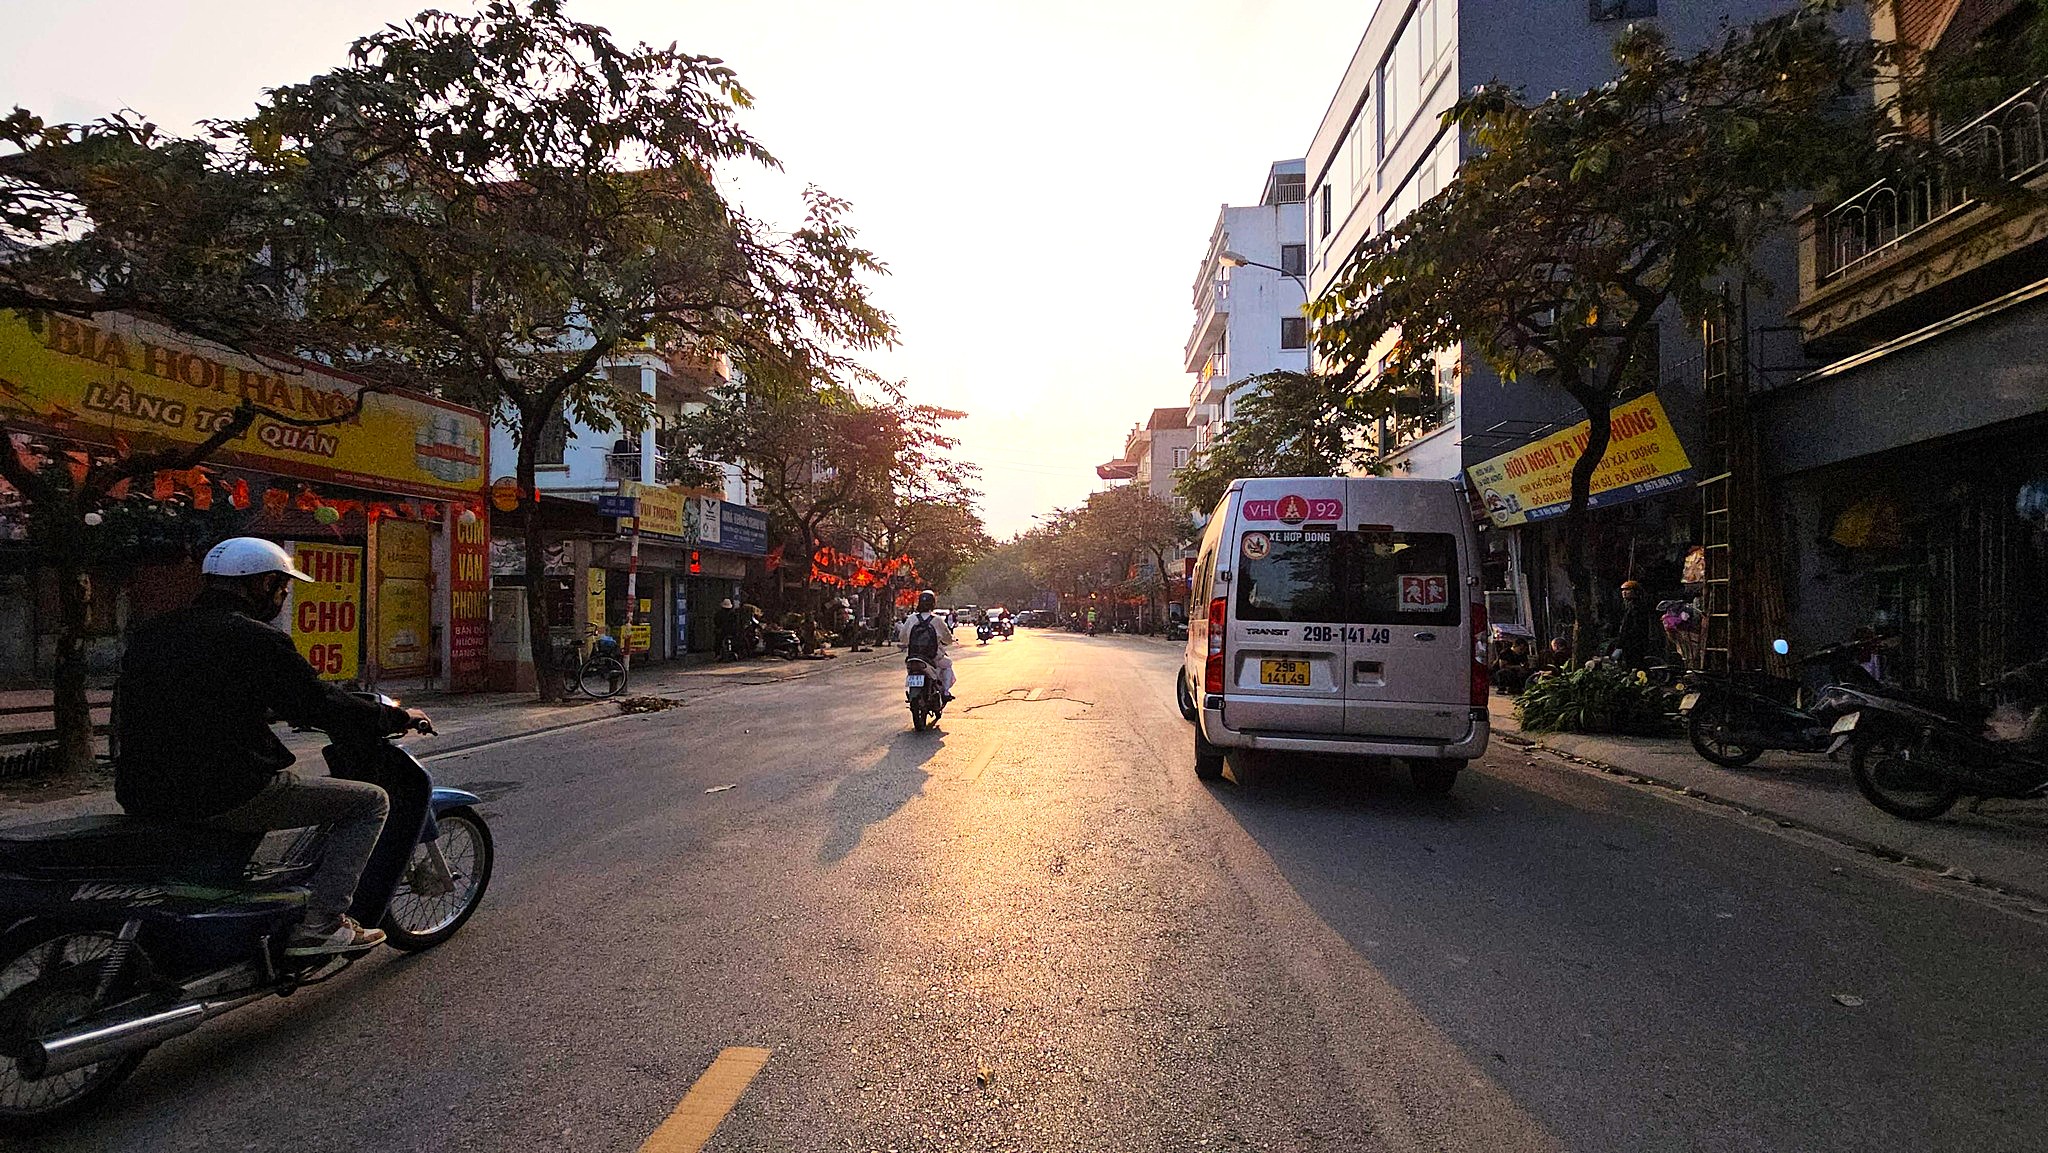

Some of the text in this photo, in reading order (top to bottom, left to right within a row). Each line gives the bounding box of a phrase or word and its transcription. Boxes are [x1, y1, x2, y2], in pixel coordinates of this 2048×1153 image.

[47, 313, 133, 371] BIA
[258, 424, 340, 458] QUÁN
[1553, 440, 1576, 461] 76
[1249, 502, 1338, 517] VH 92
[1269, 532, 1281, 542] XE
[299, 550, 359, 590] THỊT
[458, 548, 483, 582] VĂN
[297, 594, 356, 634] CHÓ
[1246, 625, 1390, 644] TRANSIT 29B-141.49
[308, 643, 343, 675] 95
[1275, 662, 1296, 672] 29B
[1268, 673, 1305, 684] 141.49
